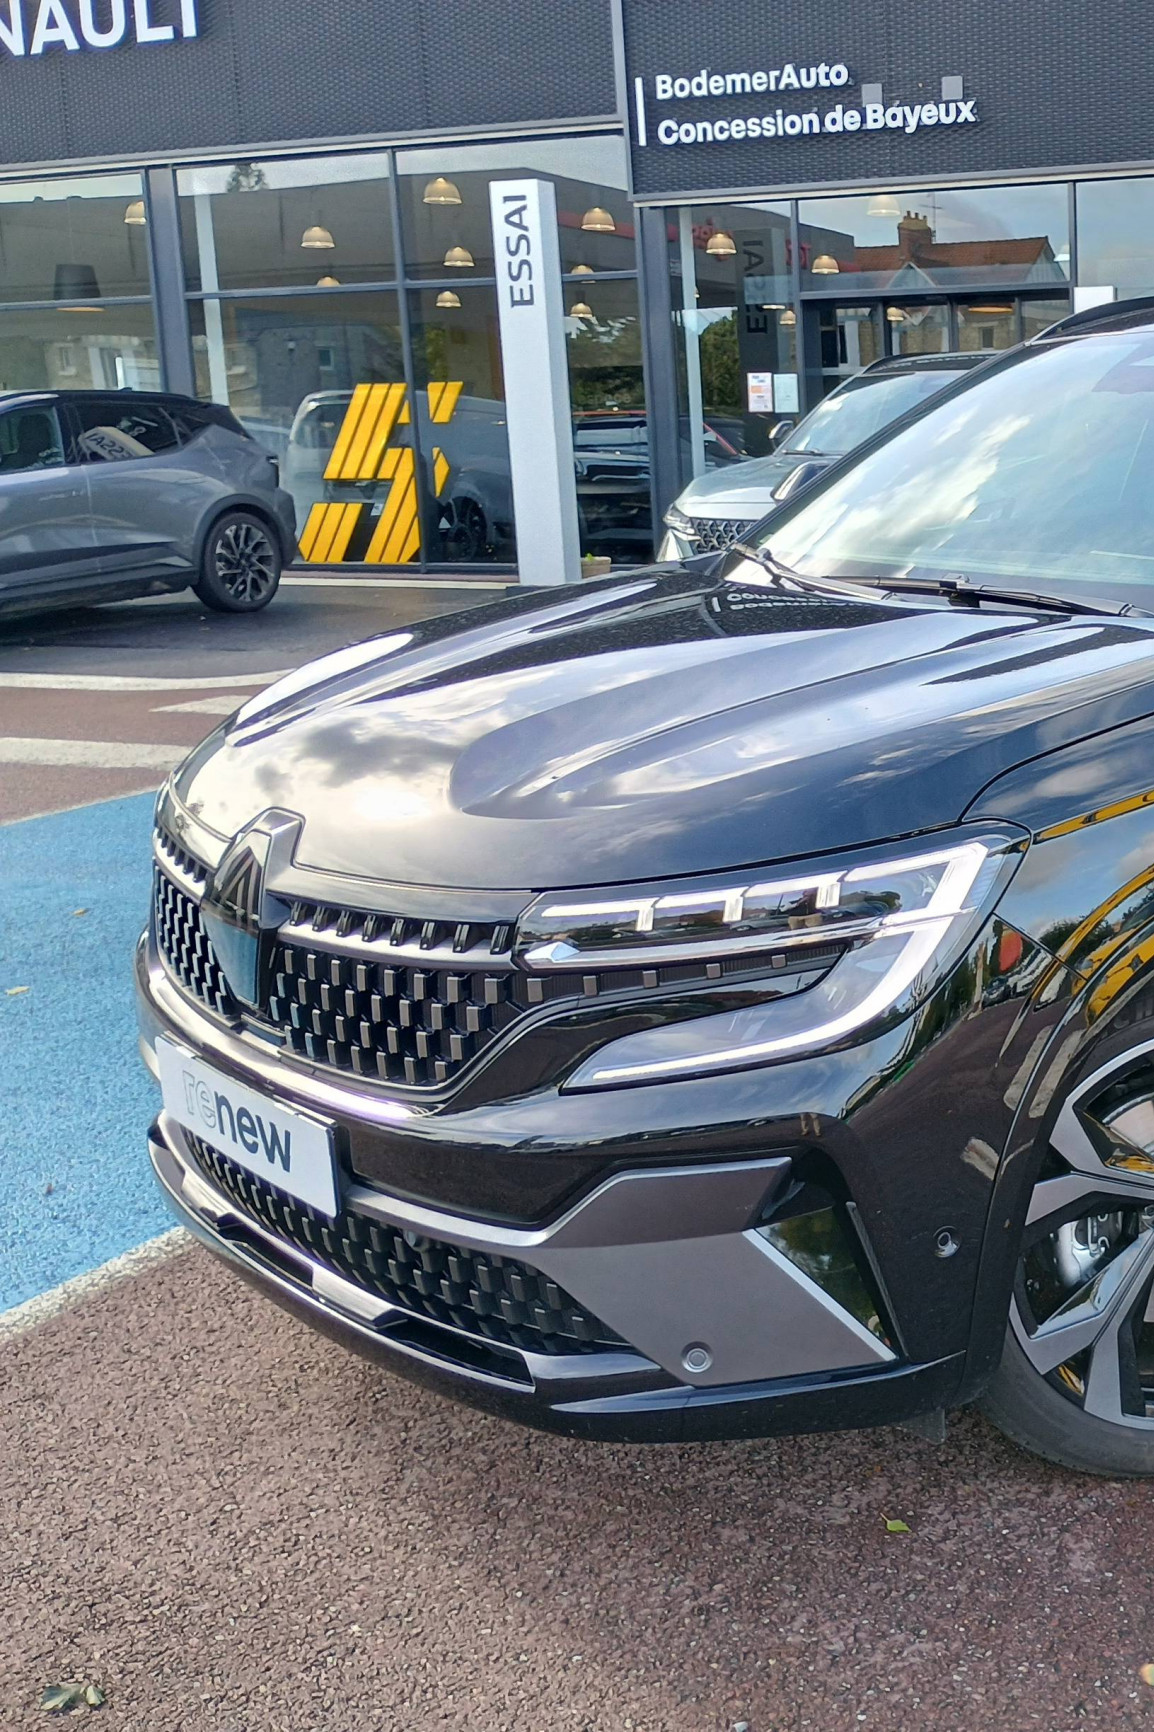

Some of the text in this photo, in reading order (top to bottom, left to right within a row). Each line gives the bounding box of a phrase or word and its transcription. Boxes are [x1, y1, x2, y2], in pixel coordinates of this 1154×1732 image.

[655, 63, 850, 100] BodemerAuto
[657, 99, 977, 146] Concession de Bayeux
[503, 194, 535, 309] ESSAI
[182, 1070, 291, 1173] renew
